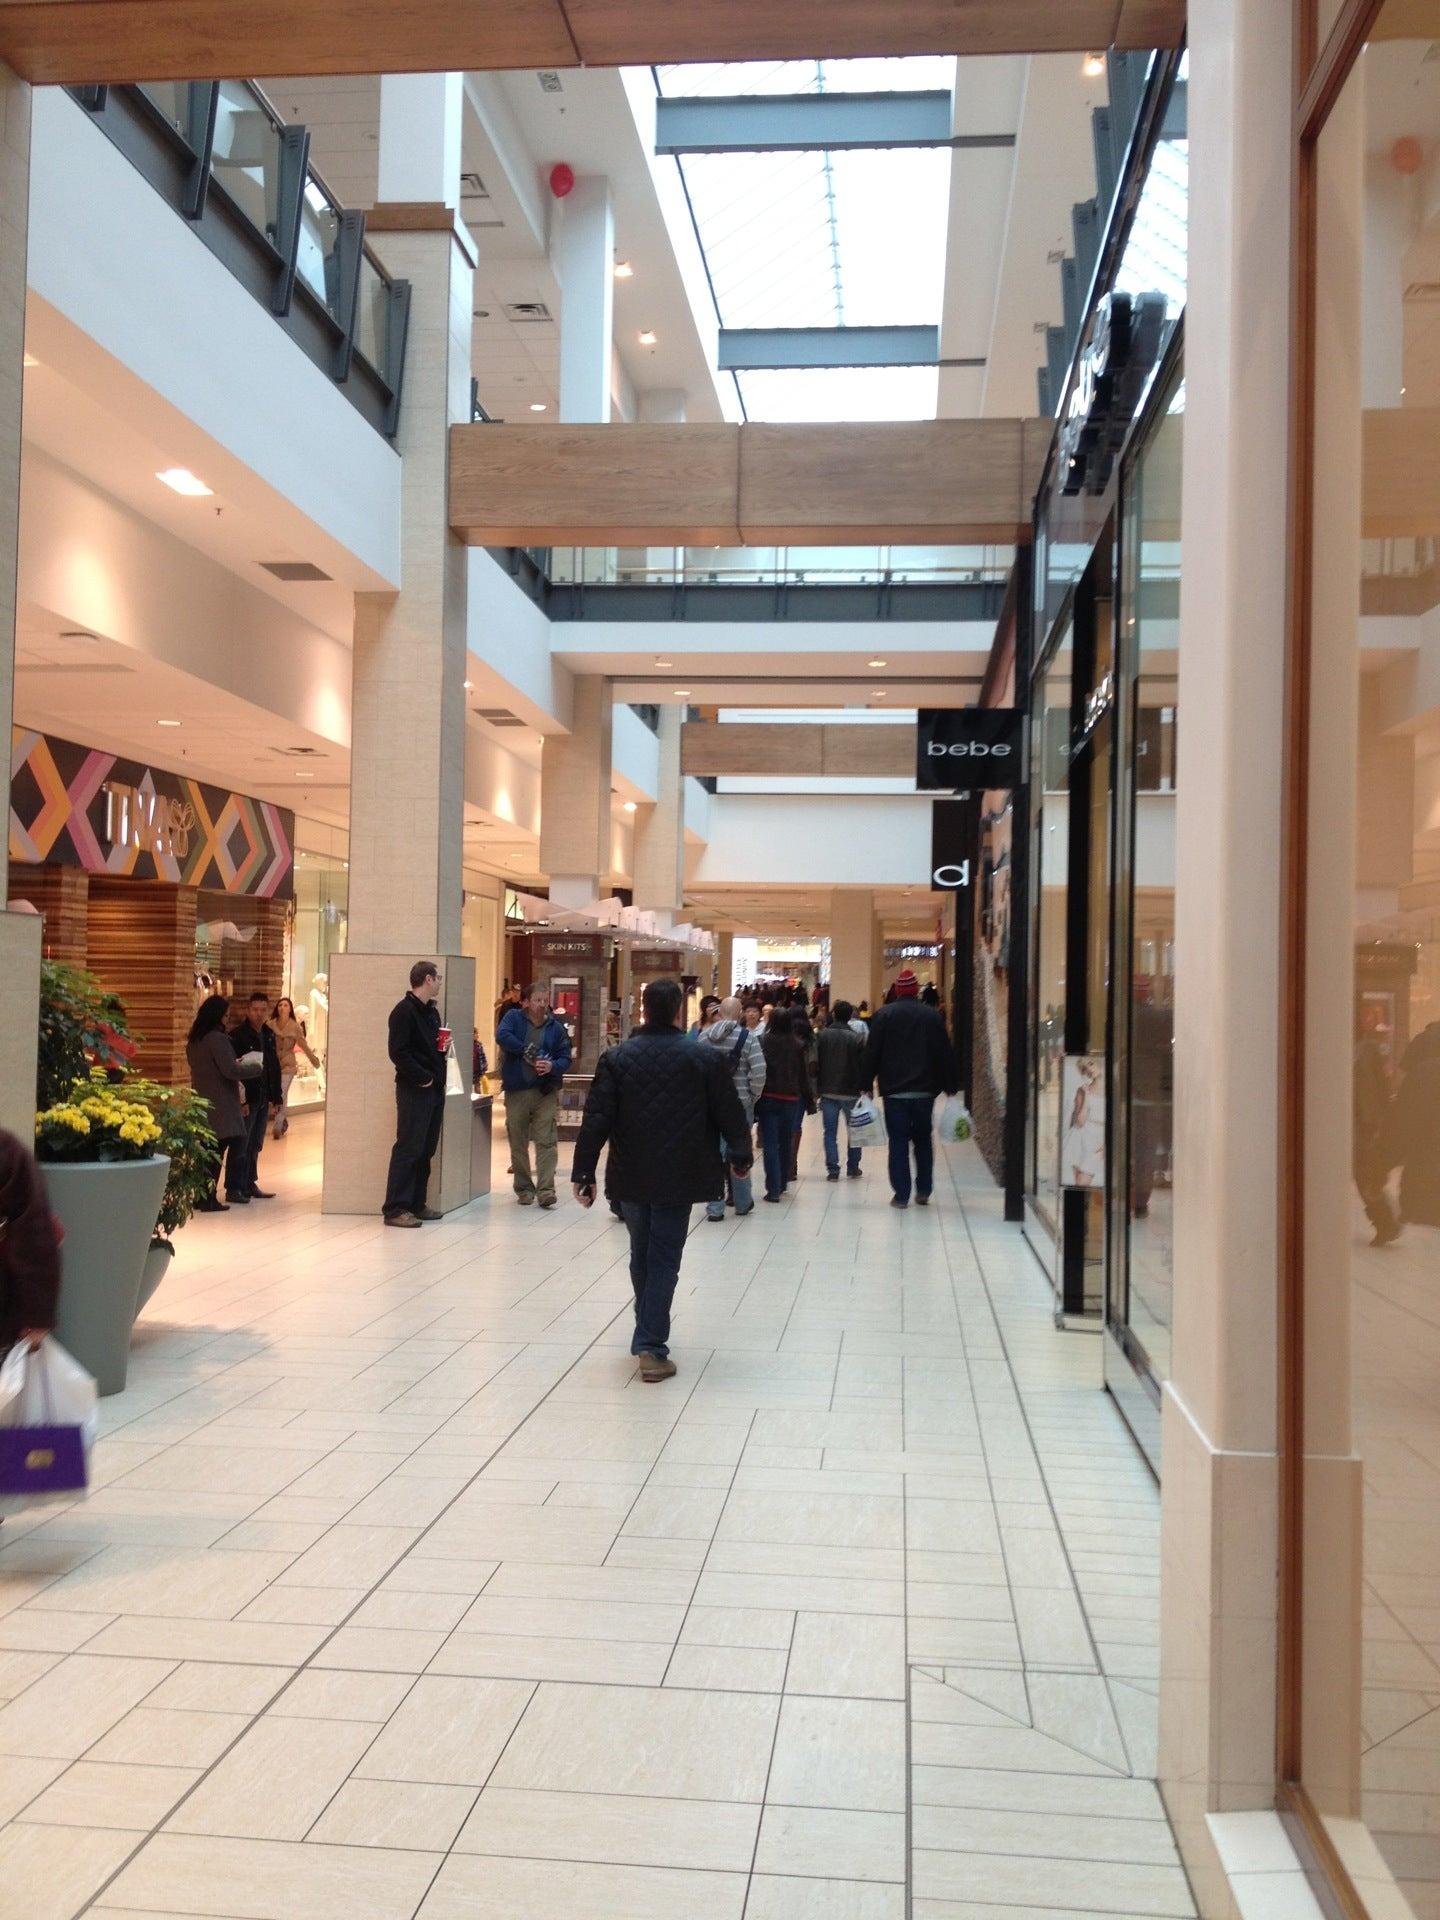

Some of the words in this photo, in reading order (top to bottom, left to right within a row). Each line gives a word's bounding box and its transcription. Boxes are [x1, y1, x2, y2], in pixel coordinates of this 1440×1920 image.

[927, 740, 1012, 757] bebe
[932, 859, 970, 887] d
[547, 943, 566, 952] SKIN
[568, 943, 587, 952] KITS
